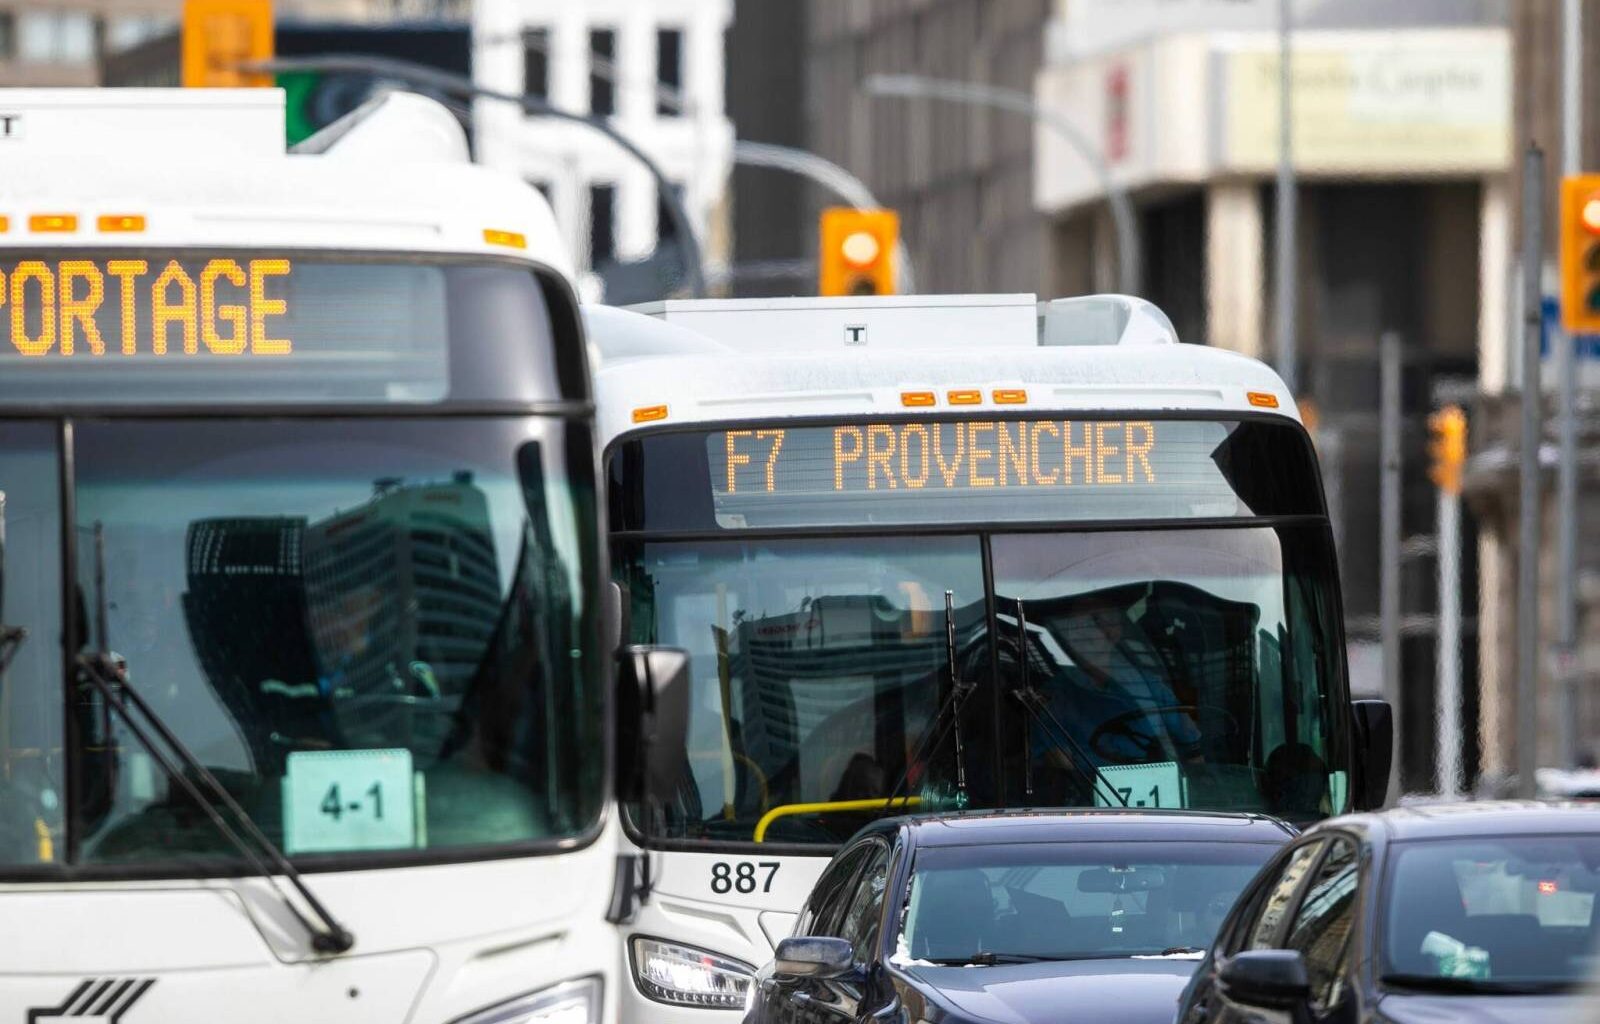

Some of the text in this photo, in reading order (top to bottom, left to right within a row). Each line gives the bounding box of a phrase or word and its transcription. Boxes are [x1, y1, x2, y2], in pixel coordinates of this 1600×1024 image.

[0, 259, 291, 356] ORTAGE
[846, 327, 865, 342] T
[726, 420, 1155, 494] F7 PROVENCHER
[320, 783, 384, 820] 4-1
[1118, 785, 1160, 807] 7-1
[710, 861, 780, 894] 887
